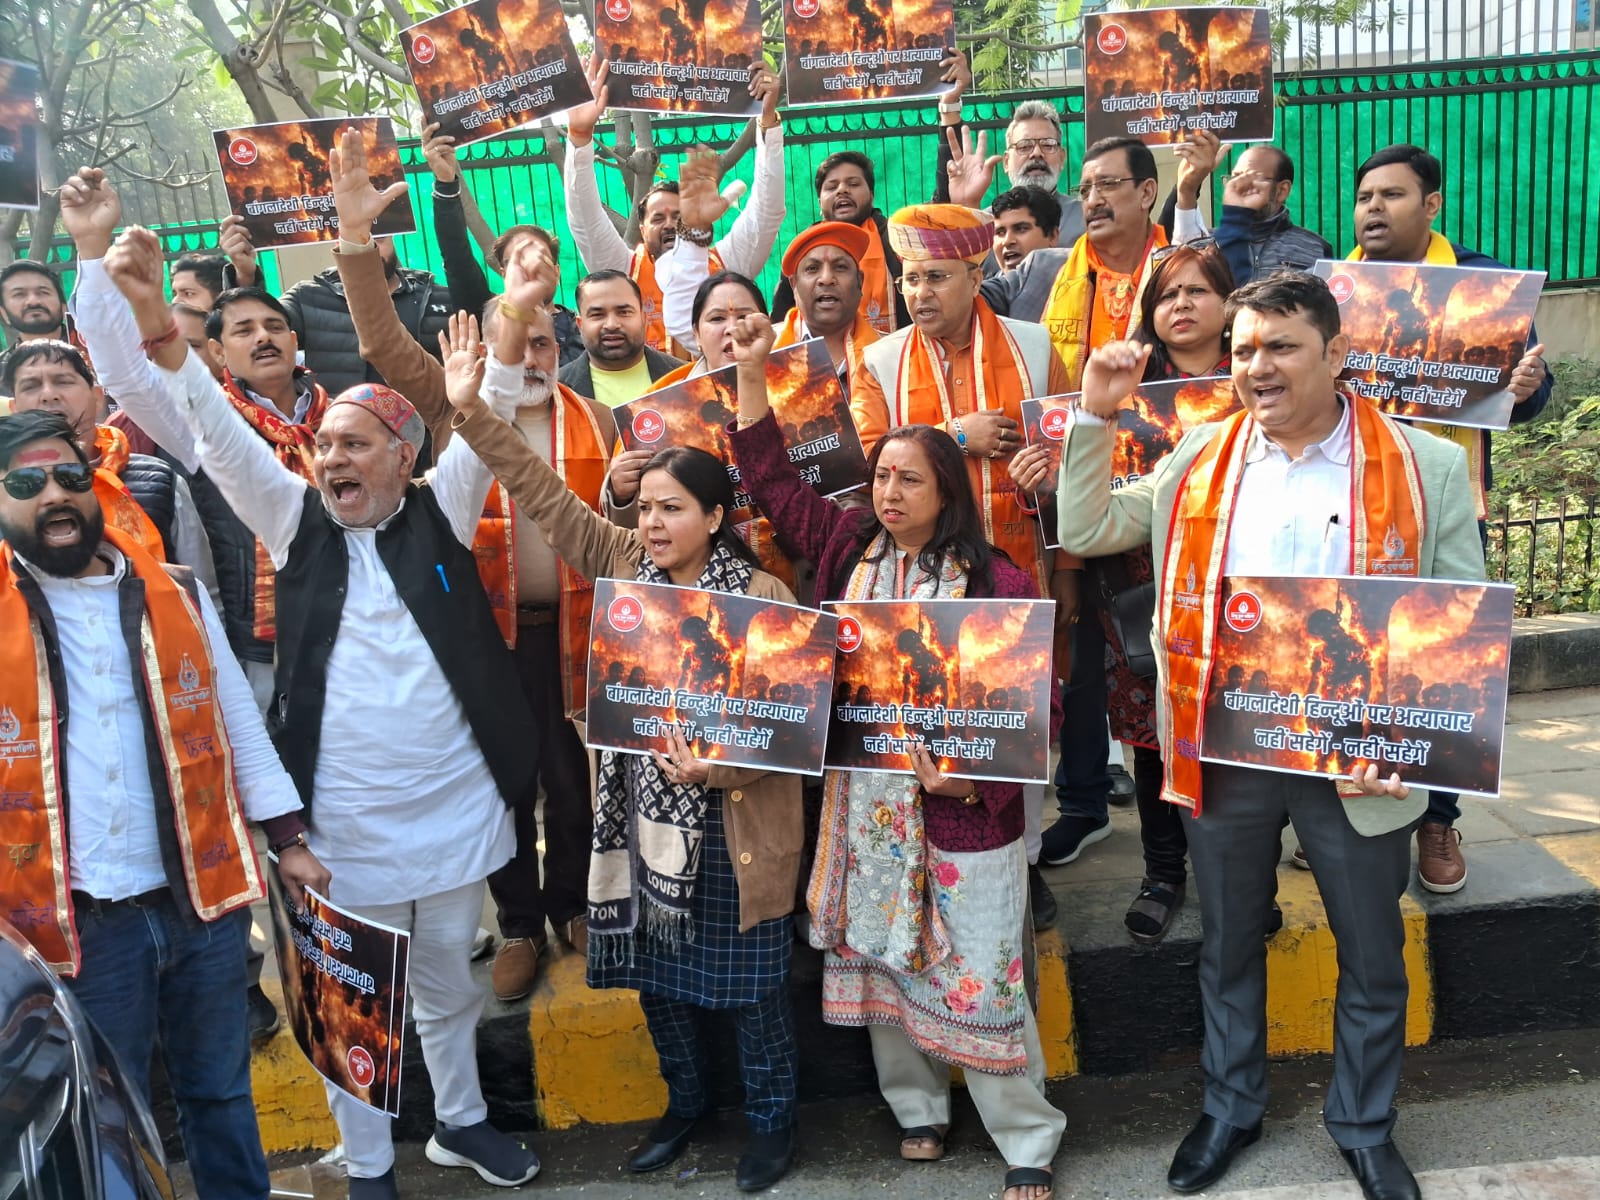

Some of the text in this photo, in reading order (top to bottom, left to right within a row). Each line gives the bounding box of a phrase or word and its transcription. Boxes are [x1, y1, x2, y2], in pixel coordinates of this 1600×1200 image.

[800, 50, 849, 70] बांगलादेशी
[887, 50, 901, 64] पर
[902, 48, 943, 61] अत्याचार
[609, 59, 658, 75] बांगलादेशी
[696, 67, 709, 79] पर
[711, 68, 751, 82] अत्याचार
[823, 74, 846, 90] नहीं
[876, 71, 898, 87] नहीं
[433, 88, 479, 115] बांगलादेशी
[512, 73, 527, 88] पर
[527, 58, 567, 83] अत्याचार
[631, 82, 653, 97] नहीं
[684, 86, 705, 101] नहीं
[461, 108, 483, 130] नहीं
[510, 94, 532, 113] नहीं
[1102, 92, 1157, 112] बांगलादेशी
[1199, 91, 1215, 105] पर
[1216, 90, 1259, 104] अत्याचार
[1127, 116, 1152, 134] नहीं
[1186, 113, 1211, 129] नहीं
[246, 197, 299, 215] बांगलादेशी
[274, 218, 297, 234] नहीं
[1042, 318, 1084, 337] जय
[1423, 362, 1441, 377] पर
[1442, 364, 1501, 383] अत्याचार
[1401, 385, 1432, 402] नहीं
[787, 432, 840, 463] अत्याचार
[606, 682, 671, 707] बांगलादेशी
[725, 697, 745, 714] पर
[746, 700, 808, 723] अत्याचार
[1224, 688, 1300, 715] बांगलादेशी
[1364, 703, 1393, 723] पर
[1395, 707, 1474, 732] अत्याचार
[837, 703, 898, 724] बांगलादेशी
[946, 710, 965, 726] पर
[968, 711, 1027, 729] अत्याचार
[633, 717, 662, 737] नहीं
[704, 724, 736, 744] नहीं
[864, 734, 892, 753] नहीं
[932, 736, 962, 756] नहीं
[1254, 726, 1291, 750] नहीं
[1343, 735, 1384, 760] नहीं
[647, 871, 681, 898] LOUIS
